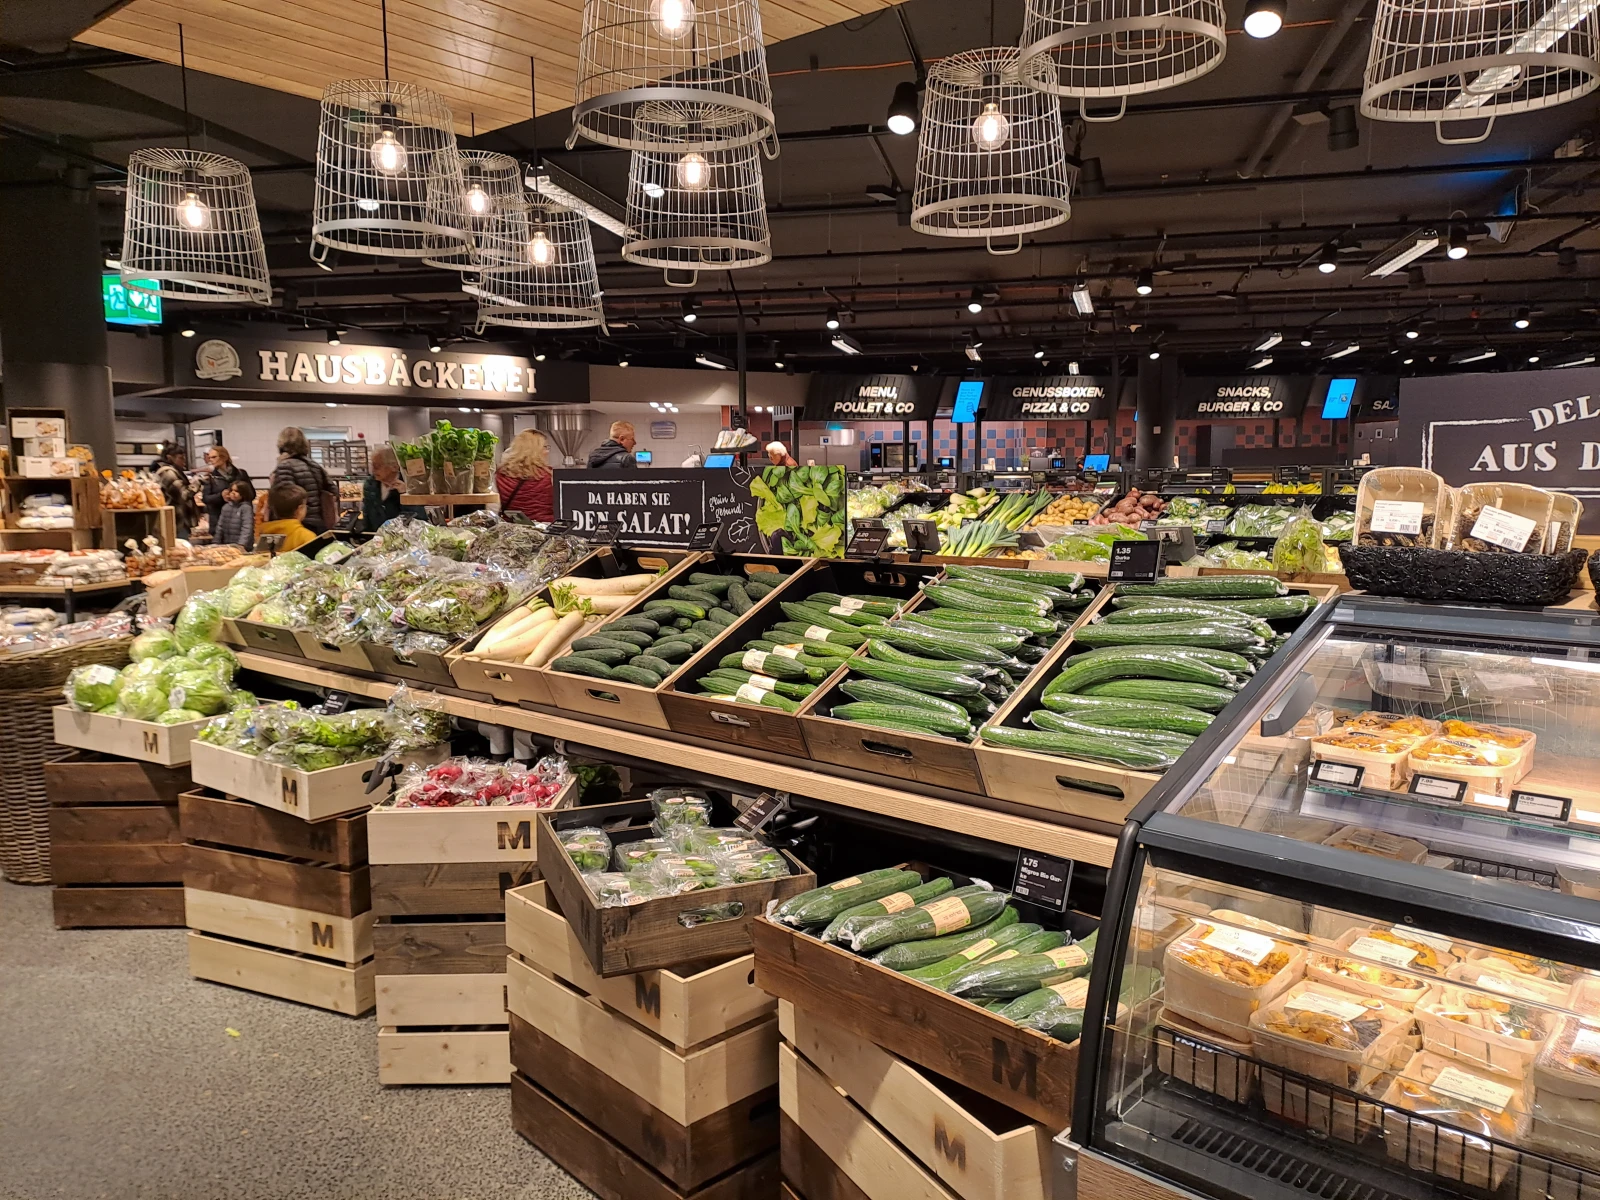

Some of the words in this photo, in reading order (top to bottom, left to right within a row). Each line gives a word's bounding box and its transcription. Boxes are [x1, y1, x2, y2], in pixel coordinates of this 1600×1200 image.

[258, 350, 538, 393] HAUSBÄCKEREI
[858, 386, 898, 400] MENU,
[1012, 386, 1105, 399] GENUSSBOXEN,
[1217, 386, 1271, 399] SNACKS,
[833, 401, 882, 413] POULET
[883, 401, 894, 413] &
[895, 401, 915, 413] CO
[1021, 402, 1058, 413] PIZZA
[1059, 402, 1069, 413] &
[1070, 402, 1090, 413] CO
[1198, 402, 1250, 412] BURGER
[1251, 402, 1261, 412] &
[1262, 401, 1283, 412] CO
[1372, 400, 1395, 410] SA
[1528, 395, 1600, 432] DEL
[1469, 440, 1557, 471] AUS
[588, 491, 603, 505] DA
[607, 491, 647, 506] HABEN
[651, 491, 671, 506] SIE
[708, 493, 729, 512] grün
[571, 509, 610, 531] DEN
[616, 510, 691, 535] SALAT!
[715, 502, 744, 523] gesund!
[143, 731, 159, 754] M
[281, 776, 298, 807] M
[496, 821, 531, 850] M
[1022, 856, 1039, 868] 1.75
[1020, 866, 1040, 877] Migros
[1039, 871, 1050, 880] Bio
[311, 921, 334, 949] M
[635, 973, 661, 1020] M
[992, 1036, 1037, 1100] M
[934, 1119, 966, 1172] M
